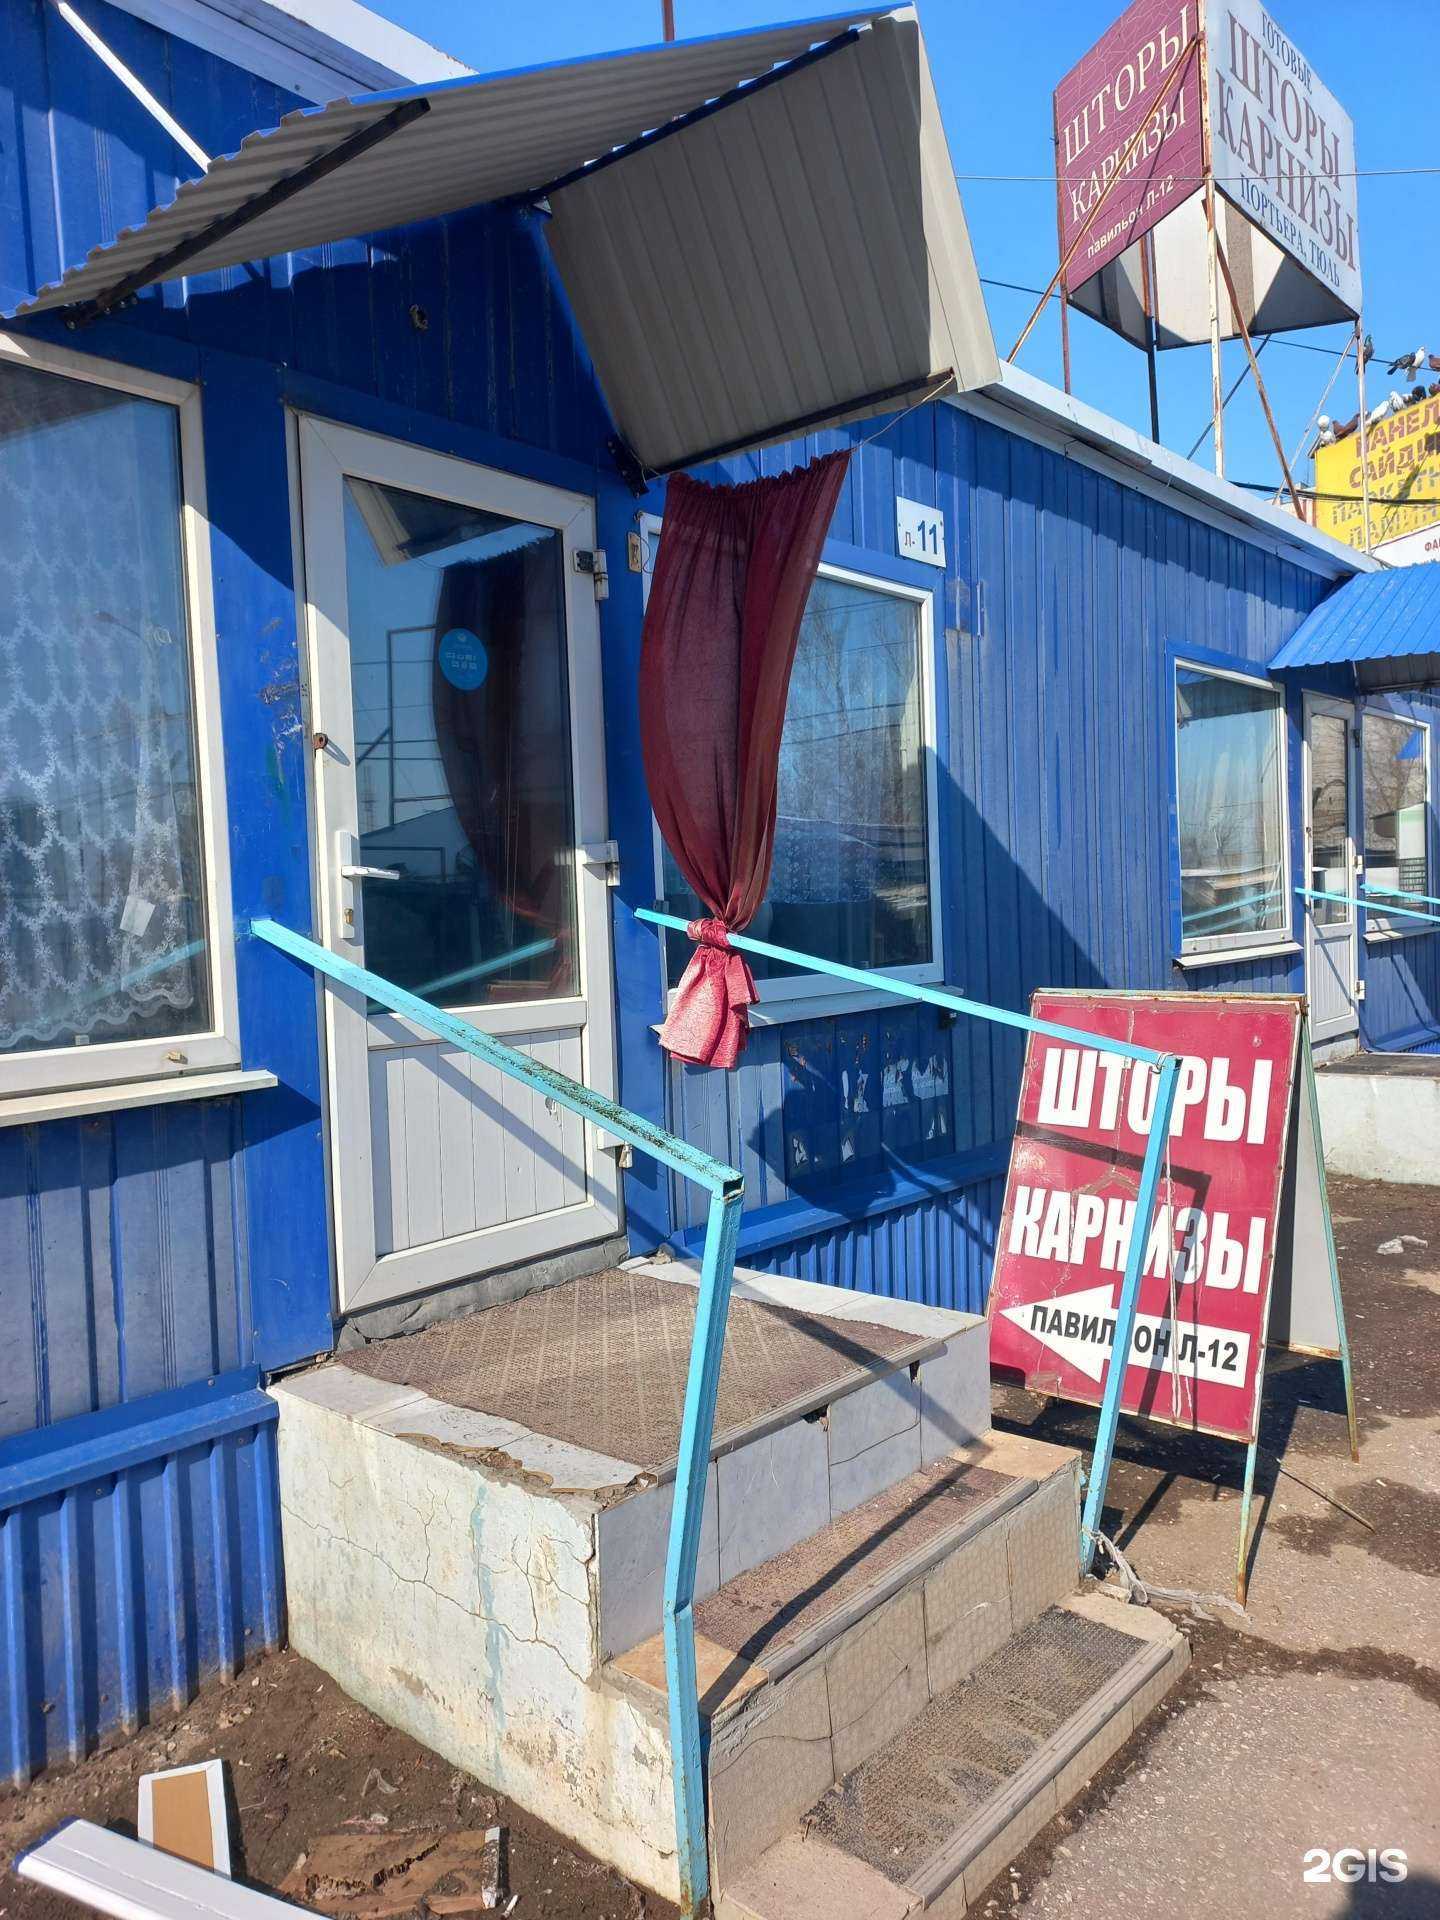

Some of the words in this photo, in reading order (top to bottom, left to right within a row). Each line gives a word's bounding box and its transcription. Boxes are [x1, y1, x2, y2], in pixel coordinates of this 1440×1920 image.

[1064, 4, 1189, 168] ШТОРЫ
[1227, 9, 1341, 191] ШТОРЫ
[1261, 10, 1312, 95] ГОТОВЫЕ
[1216, 68, 1356, 272] КАРНИЗЫ
[1087, 205, 1144, 259] павильон
[1308, 239, 1340, 287] ТЮЛЬ
[1037, 1047, 1273, 1144] ШТОРЫ
[1008, 1185, 1267, 1294] КАРНИЗЫ
[1030, 1305, 1171, 1358] ПАВИЛОН
[1178, 1333, 1240, 1372] Л-12
